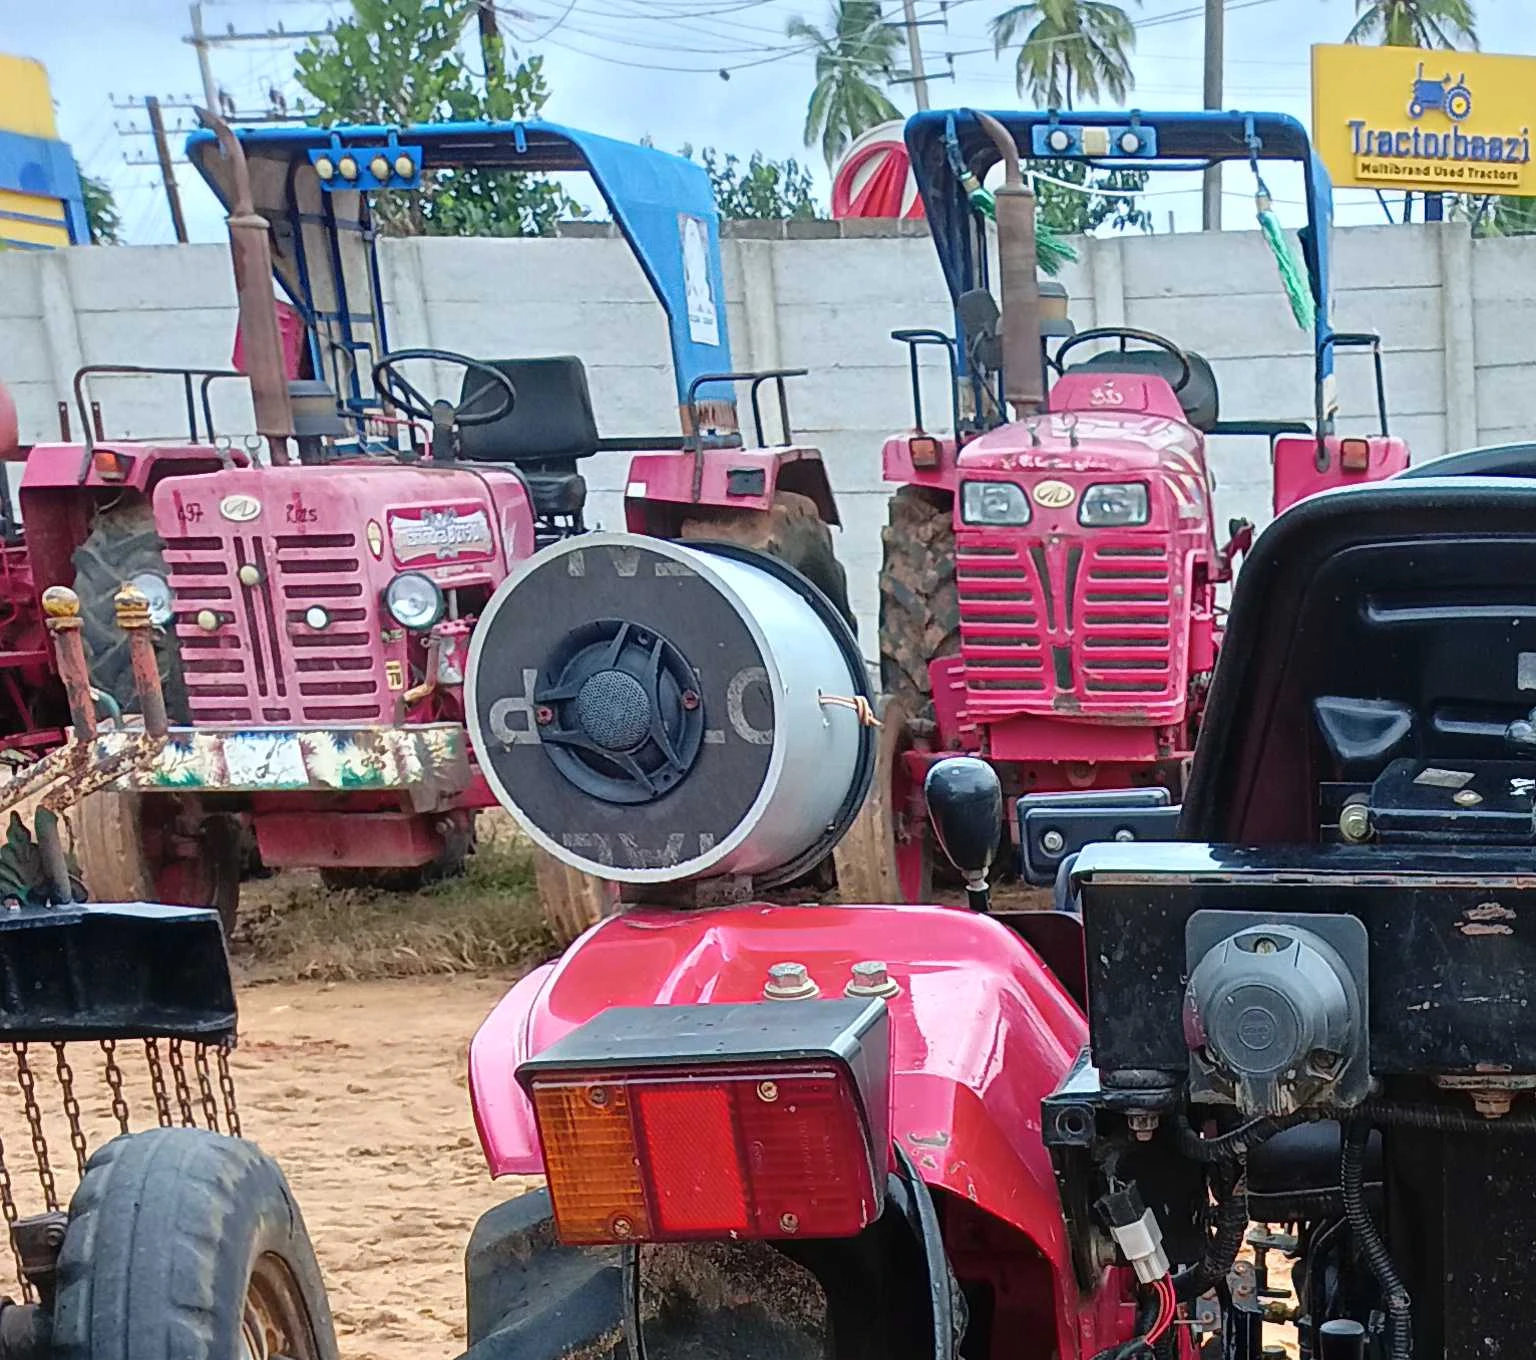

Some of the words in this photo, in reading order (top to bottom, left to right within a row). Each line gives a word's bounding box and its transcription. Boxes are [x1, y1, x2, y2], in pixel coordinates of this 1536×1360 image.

[1347, 120, 1530, 162] Tractorbaazi
[1360, 162, 1431, 177] Multibrand
[1434, 166, 1464, 178] Used
[1467, 167, 1518, 180] Tractors
